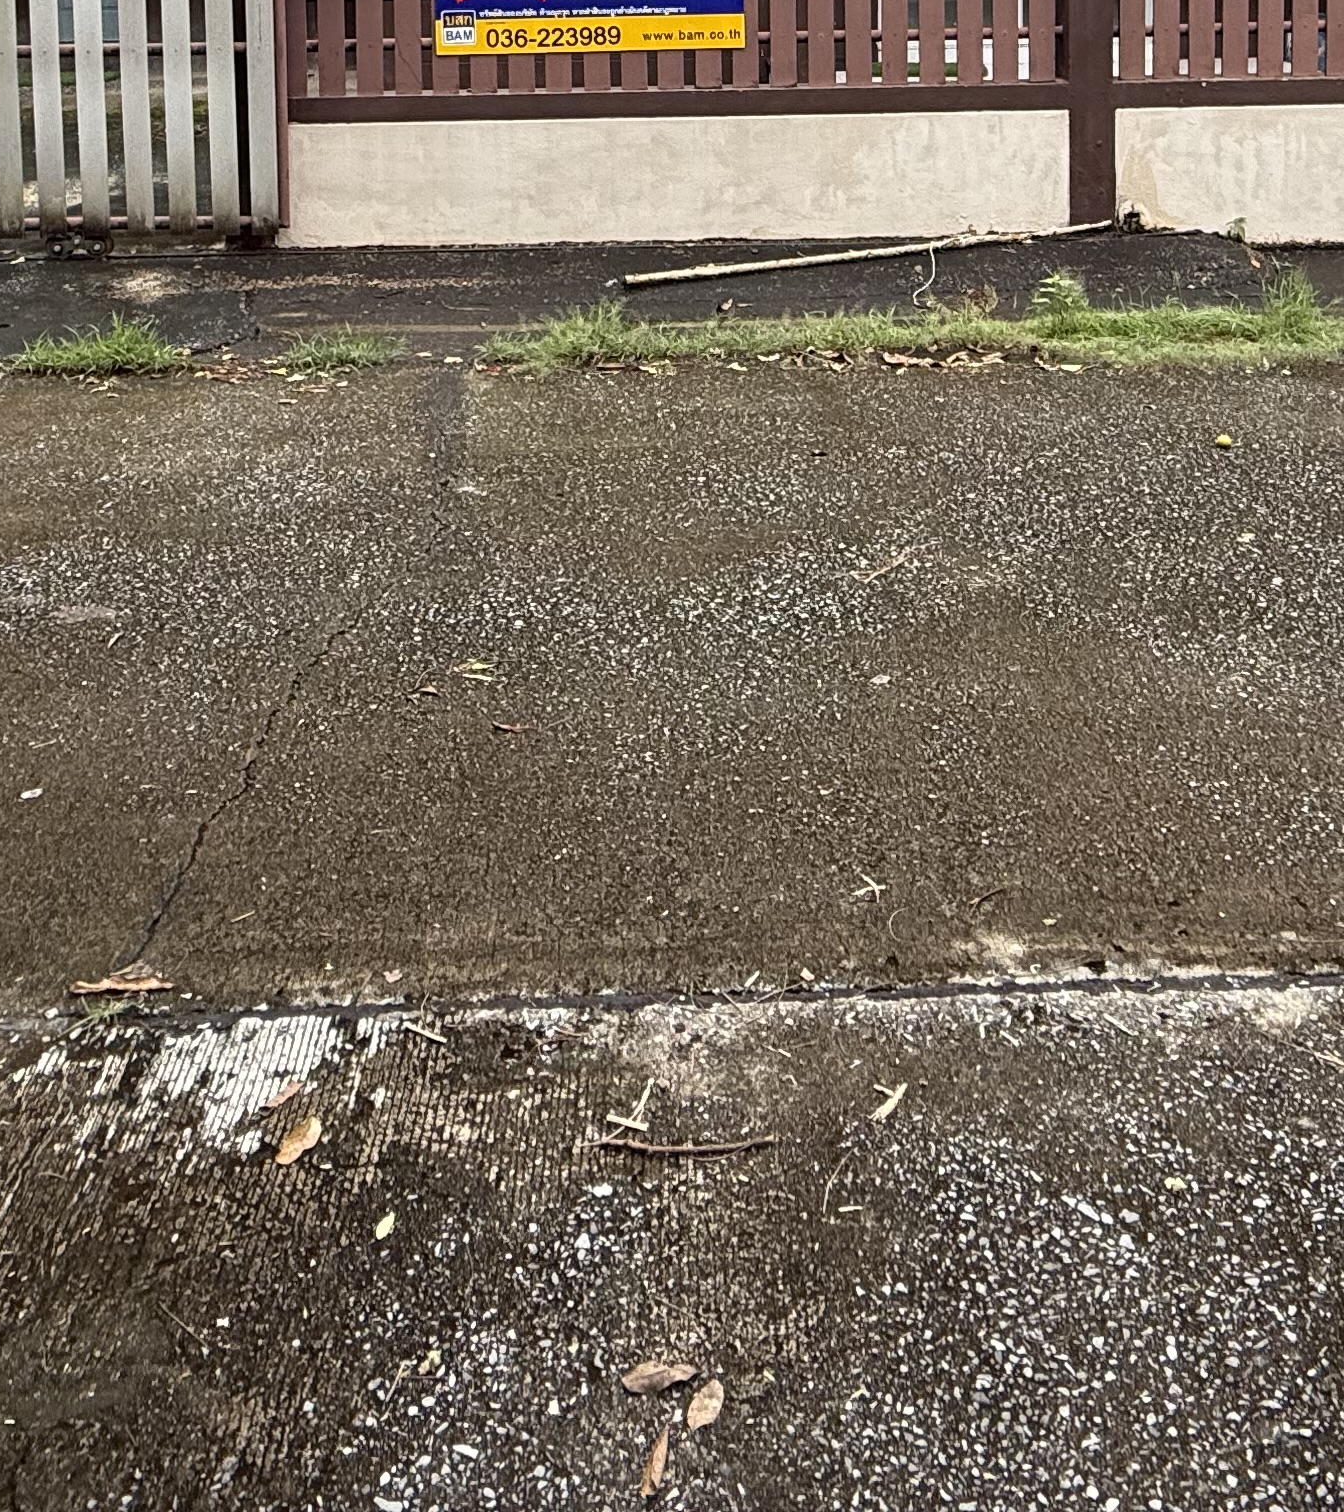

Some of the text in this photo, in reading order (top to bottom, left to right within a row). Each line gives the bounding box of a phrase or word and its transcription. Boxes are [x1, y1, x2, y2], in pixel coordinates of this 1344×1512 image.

[445, 15, 473, 26] บสก
[445, 29, 473, 41] BAM
[485, 26, 621, 48] 036-223989
